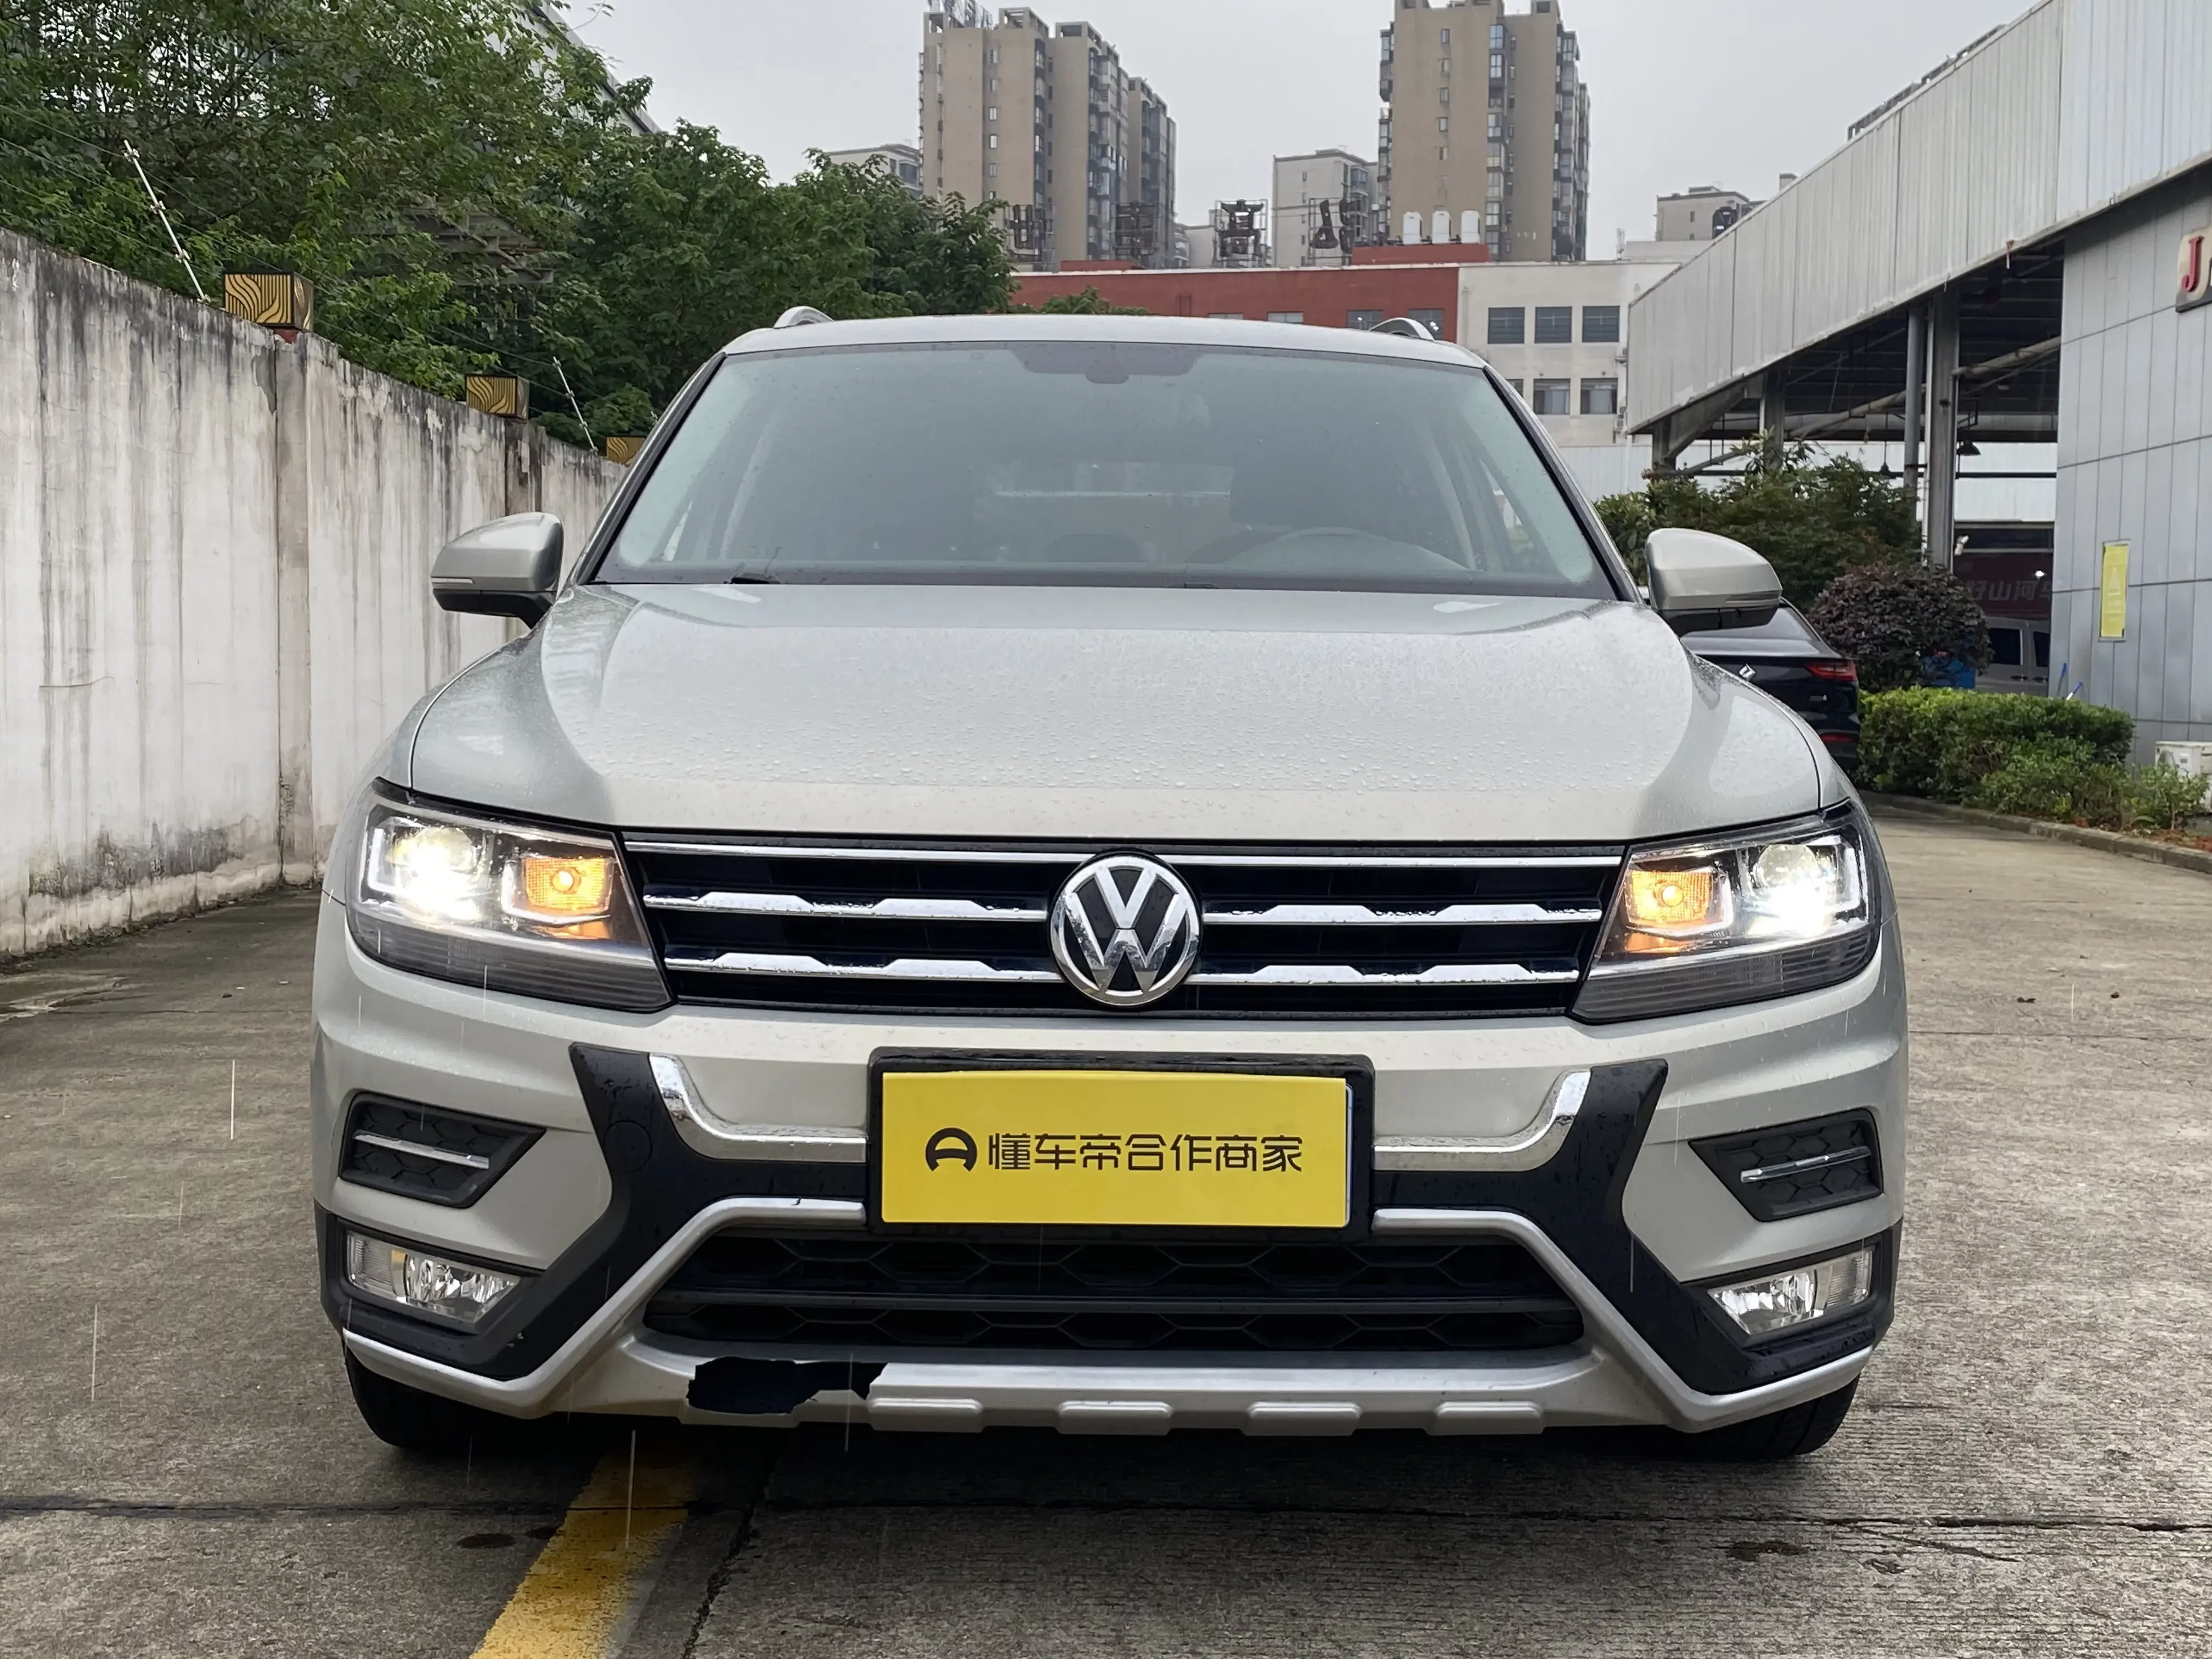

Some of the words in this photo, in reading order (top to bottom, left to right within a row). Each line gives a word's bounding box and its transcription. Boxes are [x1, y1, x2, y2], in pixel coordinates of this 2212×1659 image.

[1051, 855, 1200, 1005] VW
[988, 1132, 1303, 1172] 懂车帝合作商家
